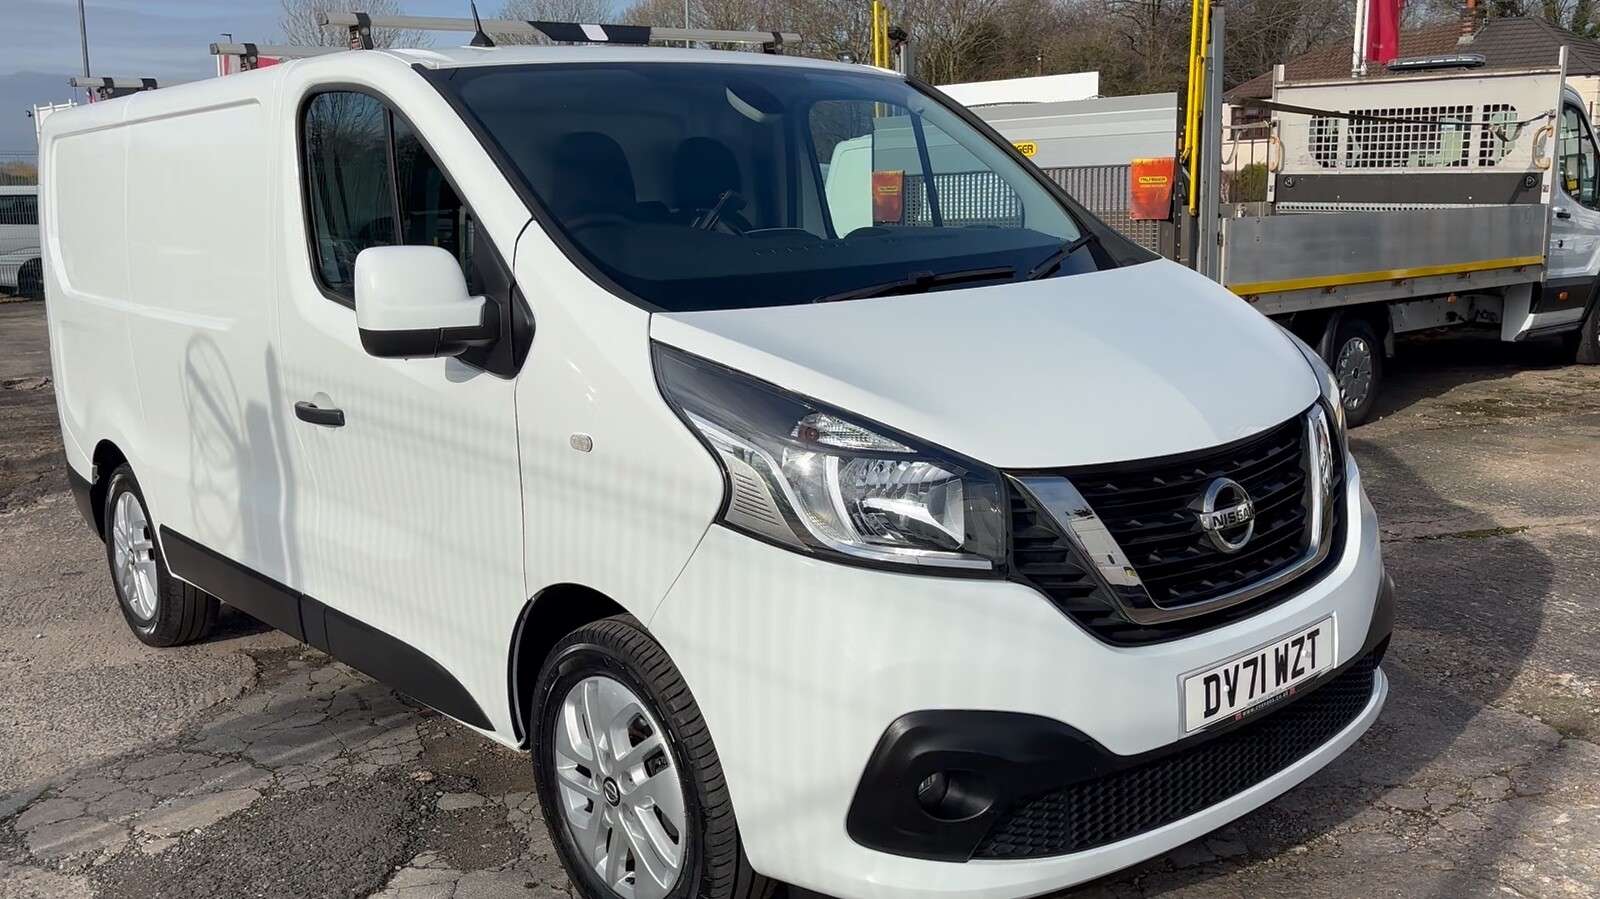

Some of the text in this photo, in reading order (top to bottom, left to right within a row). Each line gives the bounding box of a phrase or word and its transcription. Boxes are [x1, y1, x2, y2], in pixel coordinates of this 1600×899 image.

[1212, 504, 1253, 526] NISSAN
[1203, 653, 1266, 719] DV71
[1274, 628, 1320, 687] WZT
